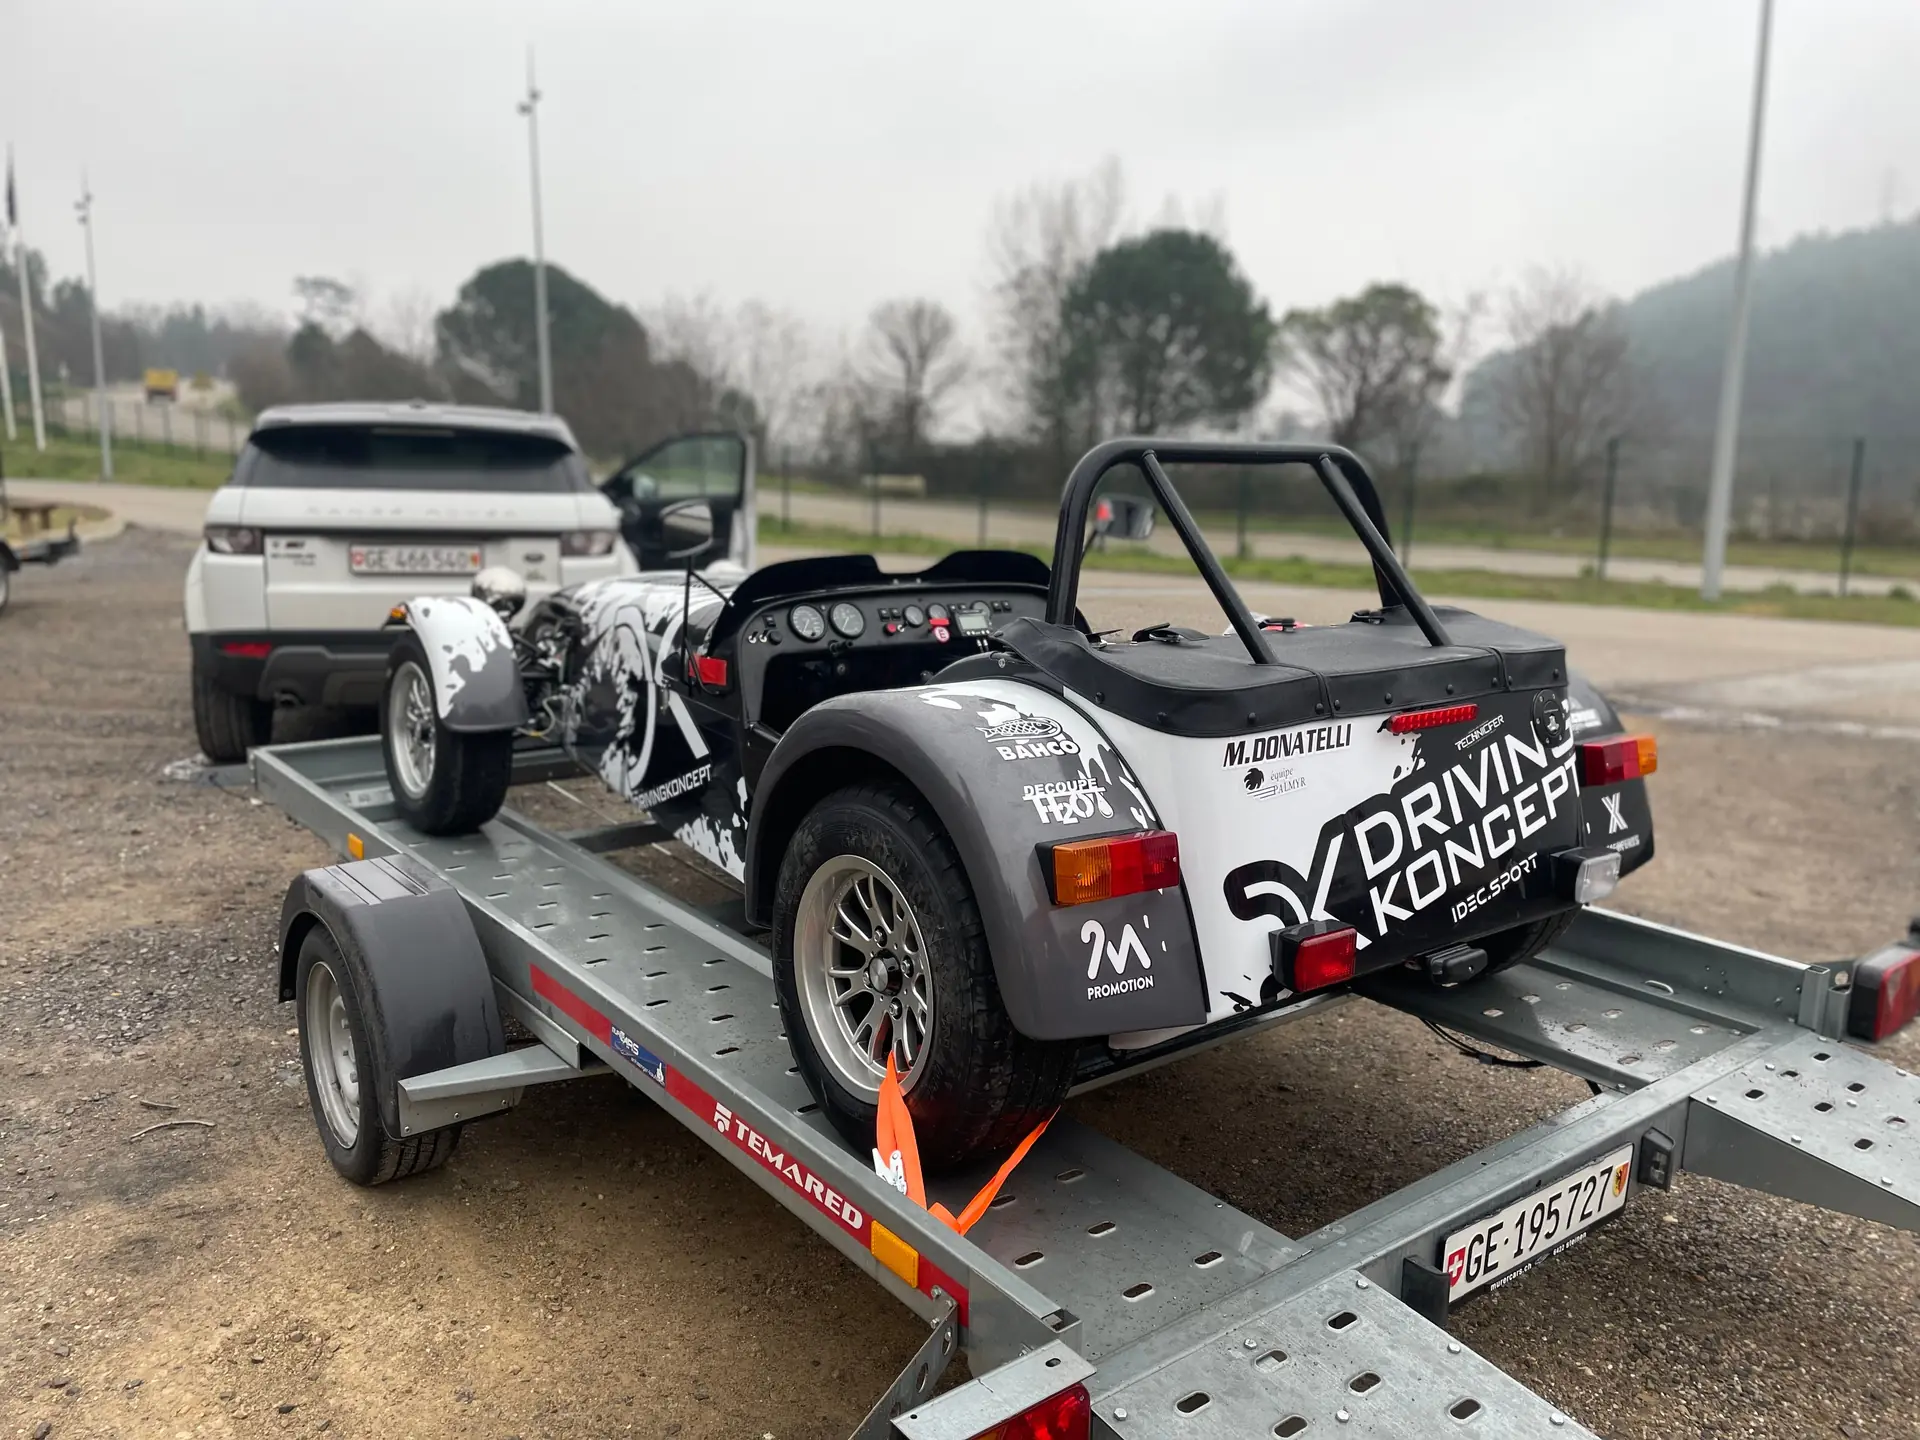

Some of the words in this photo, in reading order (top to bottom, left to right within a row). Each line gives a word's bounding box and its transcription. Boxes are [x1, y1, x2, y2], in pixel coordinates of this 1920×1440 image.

[996, 740, 1080, 761] BAHCO
[1270, 767, 1294, 781] équipe
[1023, 777, 1098, 797] DECOUPE
[1274, 776, 1307, 796] PALMYR
[1369, 752, 1580, 937] KONCEPT
[1087, 975, 1155, 1001] PROMOTION
[735, 1119, 863, 1230] TEMARED
[1489, 1262, 1533, 1292] murercars.ch
